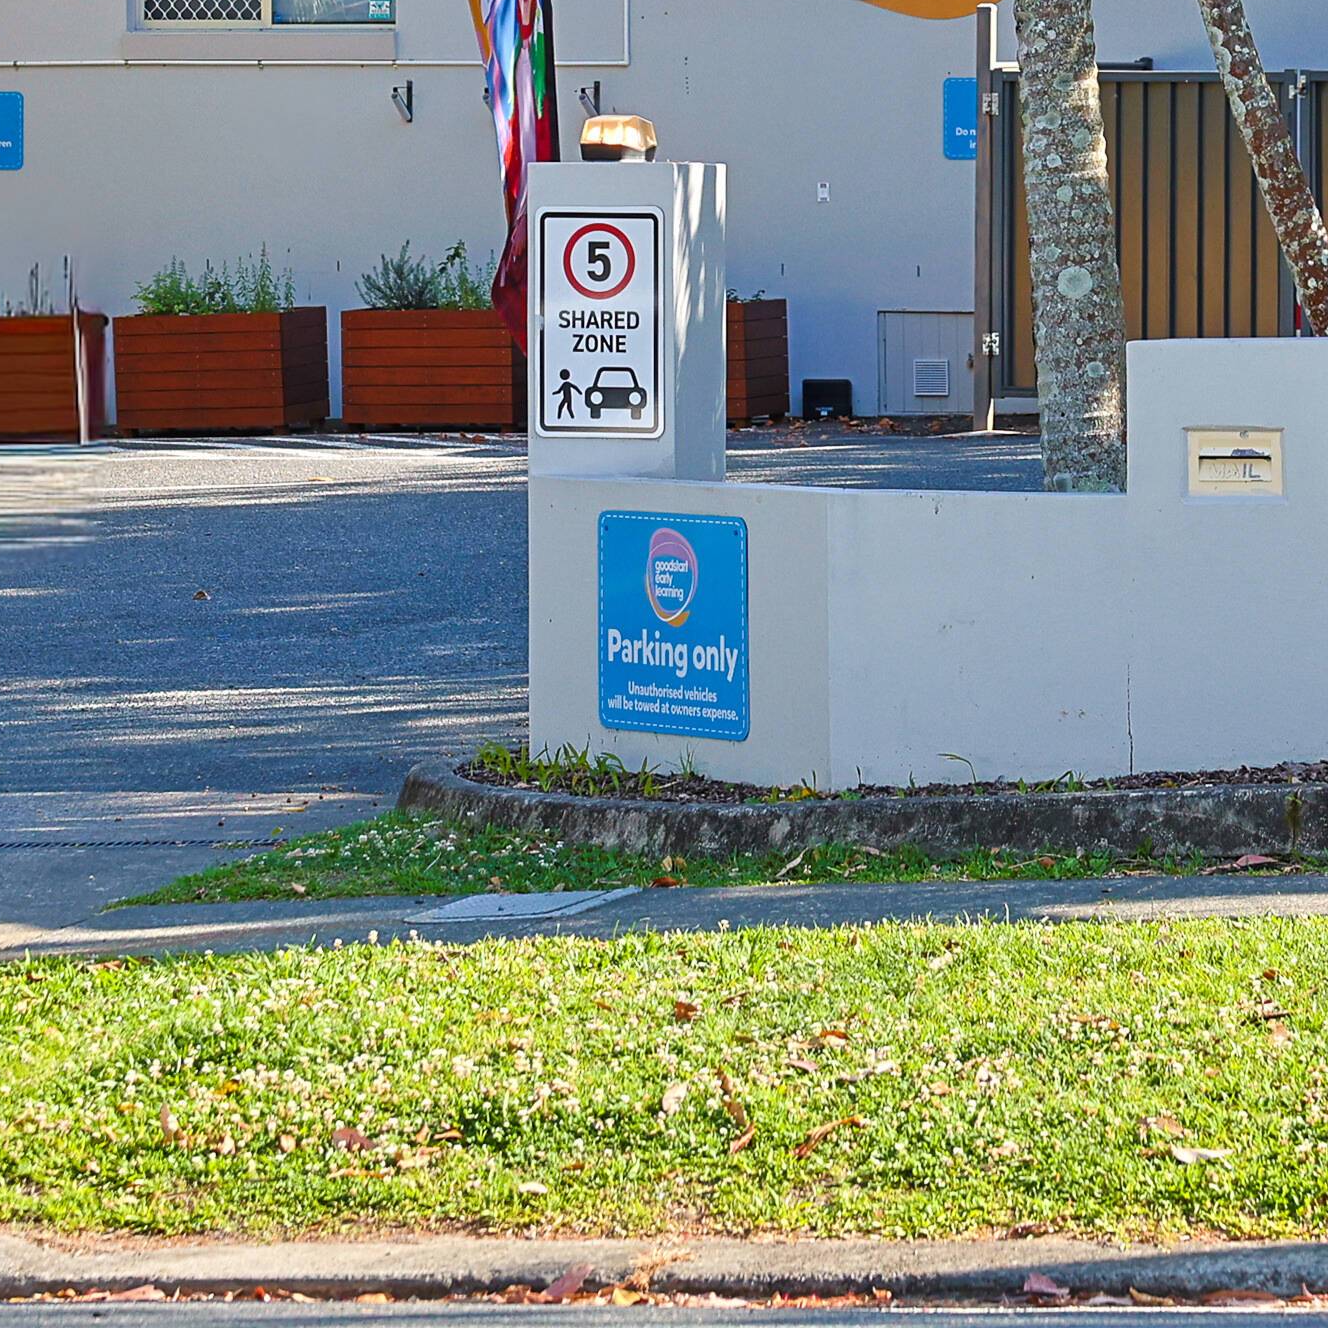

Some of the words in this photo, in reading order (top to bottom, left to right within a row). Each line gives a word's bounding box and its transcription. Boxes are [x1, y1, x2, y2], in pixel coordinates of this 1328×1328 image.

[955, 127, 969, 136] Do
[586, 240, 612, 282] 5
[558, 310, 640, 330] SHARED
[572, 334, 627, 353] ZONE
[655, 572, 673, 587] early
[607, 628, 688, 678] Parking
[692, 634, 739, 683] only
[628, 680, 683, 700] Unauthorised
[684, 685, 718, 703] vehicles
[607, 694, 622, 710] will
[623, 695, 634, 711] be
[634, 698, 660, 713] towed
[661, 703, 670, 714] at
[670, 705, 701, 718] owners
[702, 708, 739, 722] expense.
